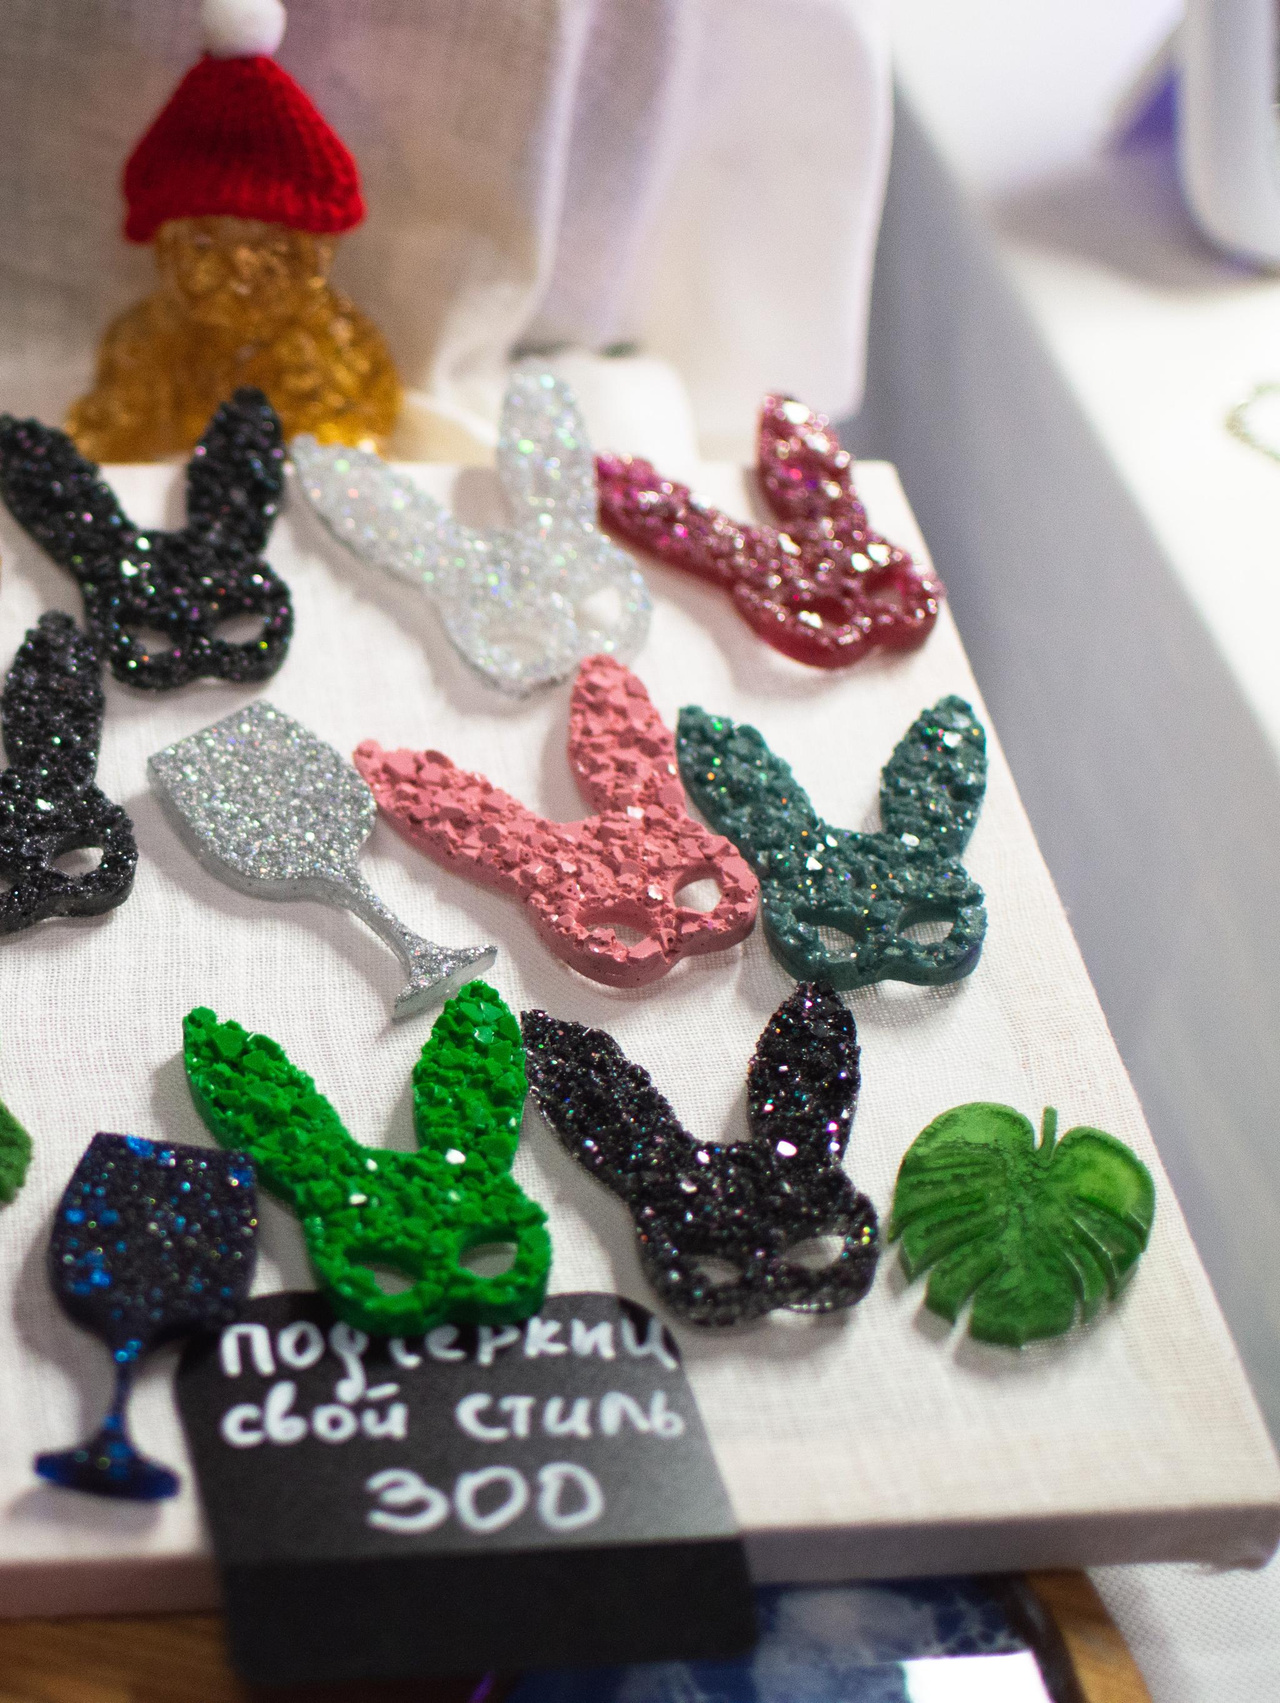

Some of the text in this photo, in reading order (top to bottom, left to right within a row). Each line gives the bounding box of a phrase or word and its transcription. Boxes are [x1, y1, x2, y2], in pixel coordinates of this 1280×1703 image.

[220, 1380, 686, 1448] свой стиль
[364, 1460, 606, 1533] 300
